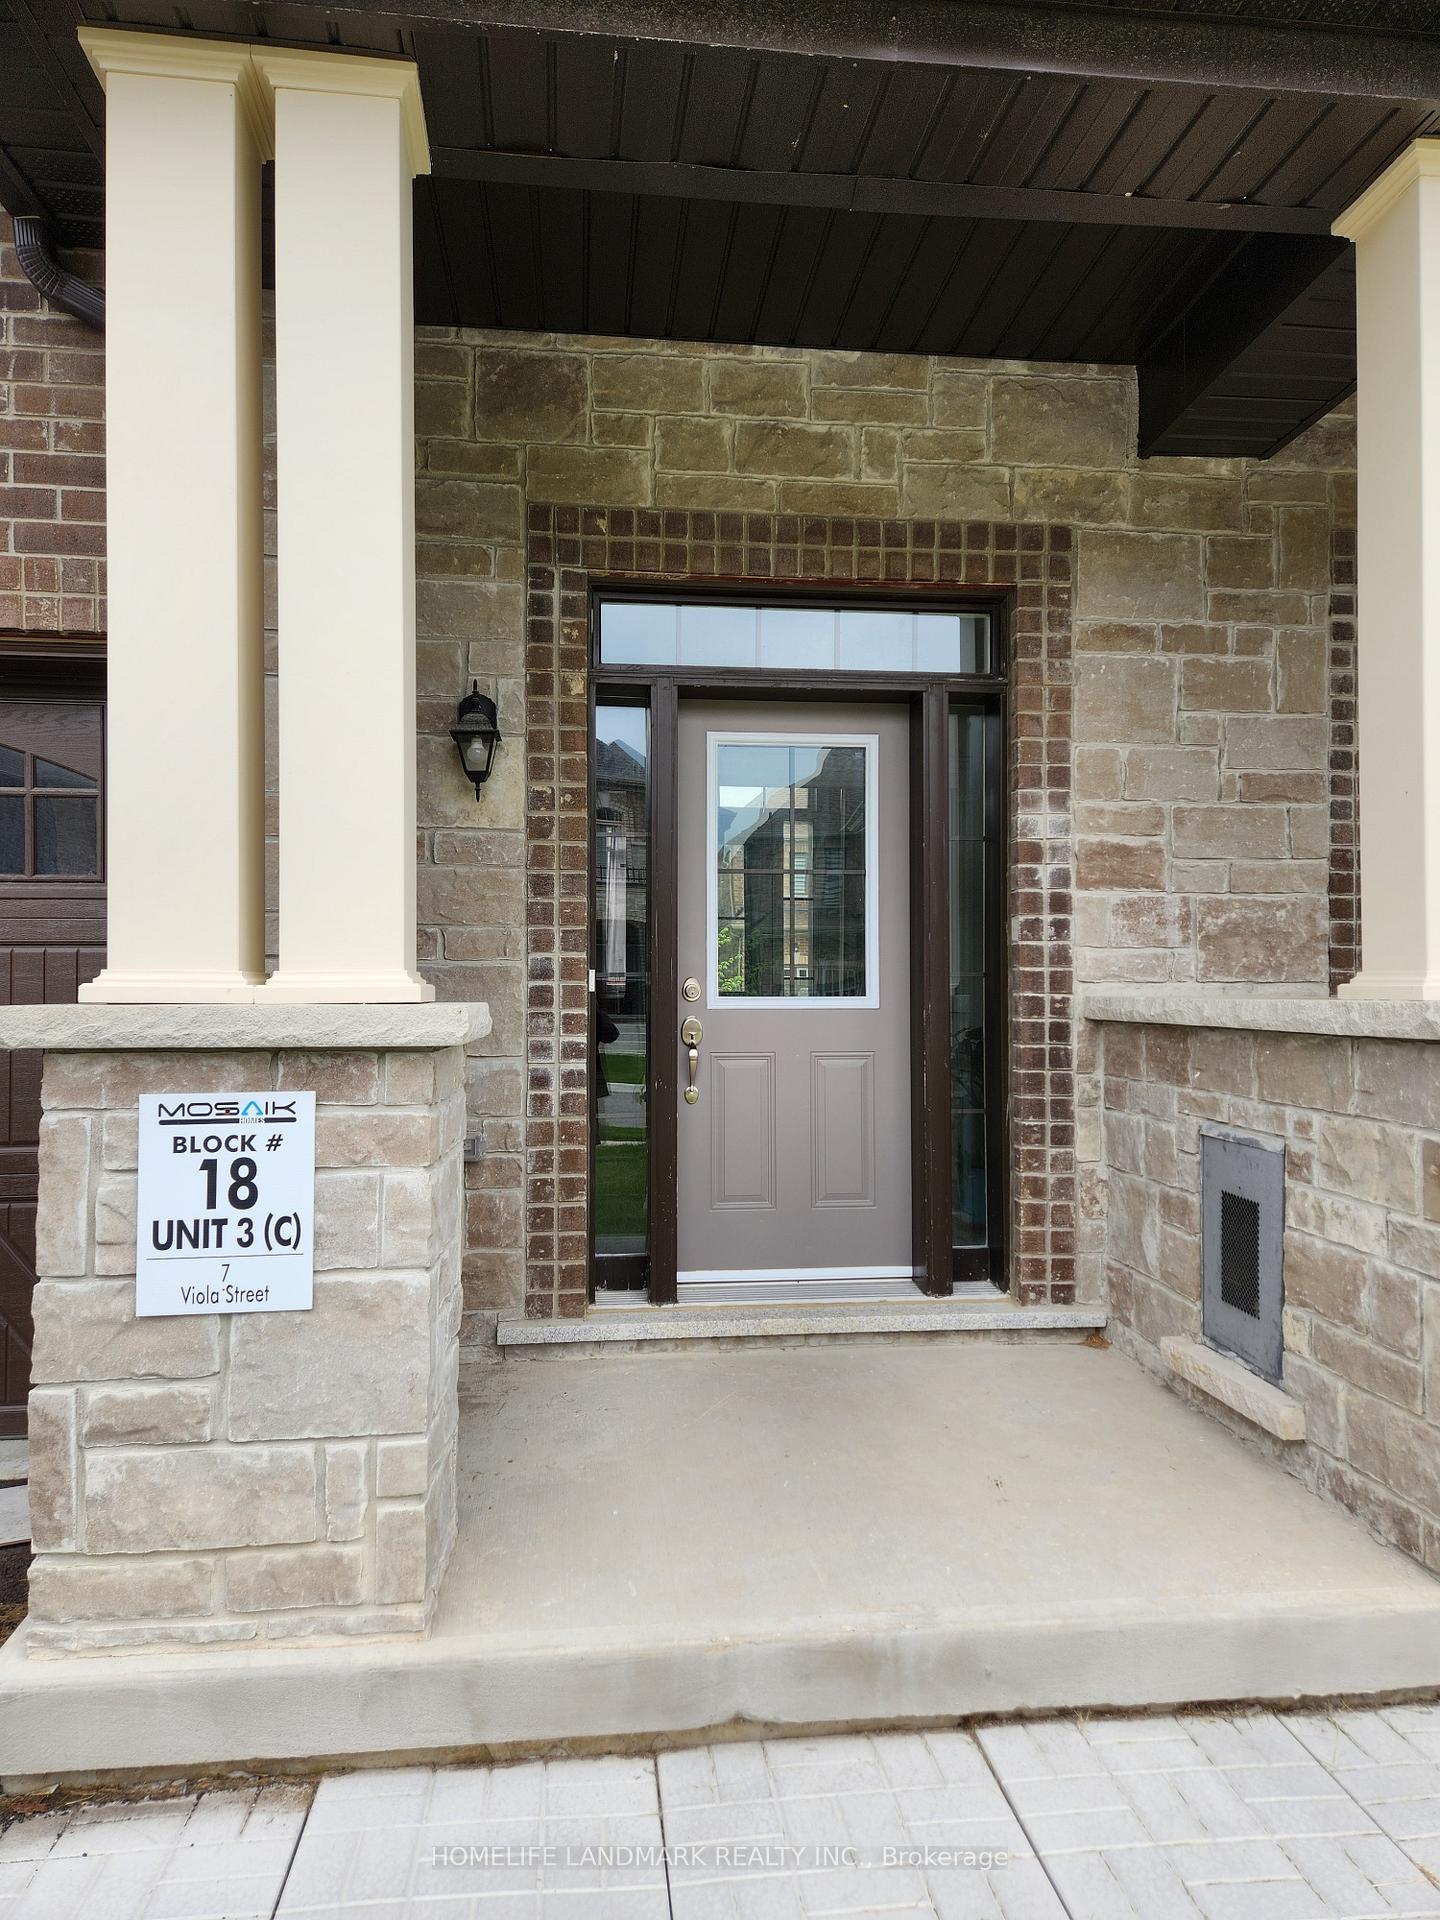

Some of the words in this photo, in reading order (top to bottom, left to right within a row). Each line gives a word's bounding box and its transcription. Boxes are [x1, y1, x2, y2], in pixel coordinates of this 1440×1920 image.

[158, 1100, 296, 1118] MOSAIK
[173, 1134, 257, 1154] BLOCK
[265, 1133, 283, 1152] #
[199, 1156, 259, 1210] 18
[152, 1218, 228, 1251] UNIT
[236, 1217, 254, 1248] 3
[264, 1212, 301, 1251] (C)
[221, 1263, 230, 1282] 7
[181, 1285, 219, 1304] Viola
[226, 1284, 270, 1303] Street
